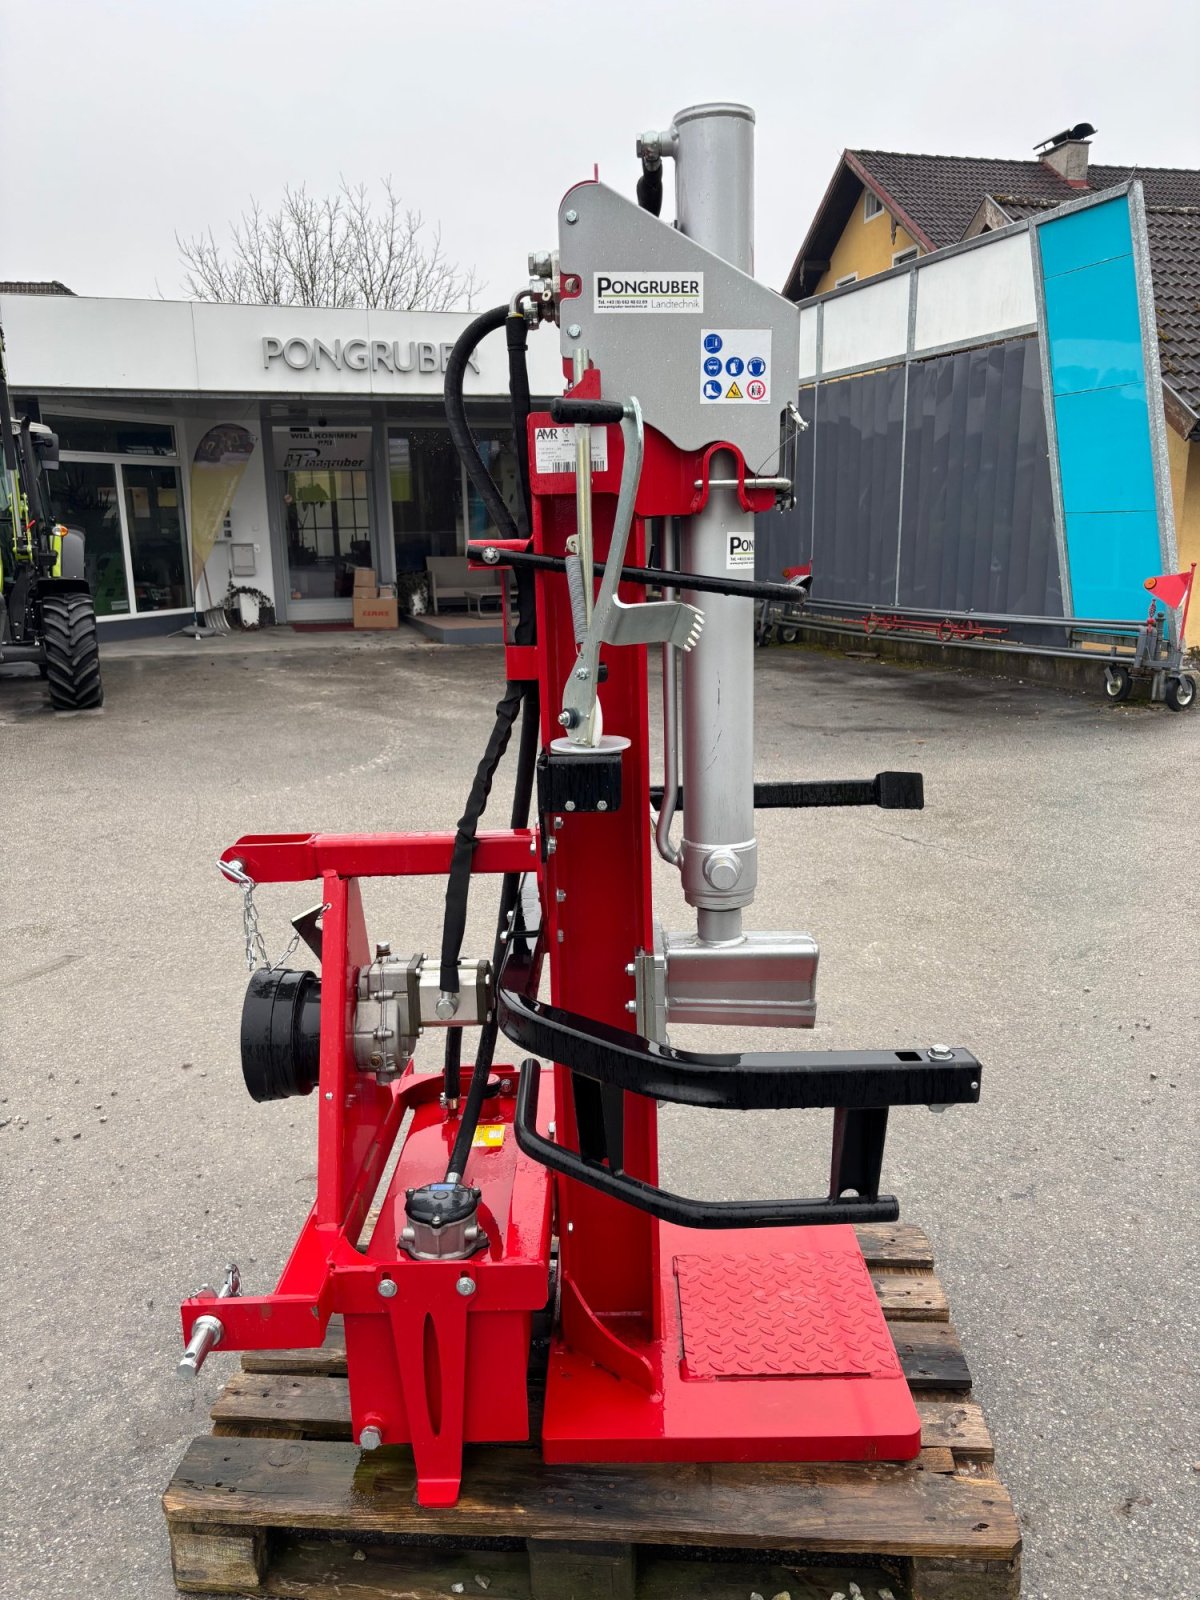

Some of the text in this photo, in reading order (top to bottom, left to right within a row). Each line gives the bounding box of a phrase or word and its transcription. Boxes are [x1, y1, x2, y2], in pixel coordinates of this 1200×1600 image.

[597, 277, 699, 298] PONGRUBER
[651, 299, 699, 309] Landtechnik
[290, 432, 357, 440] WILLKOMMEN
[536, 428, 558, 440] AMR
